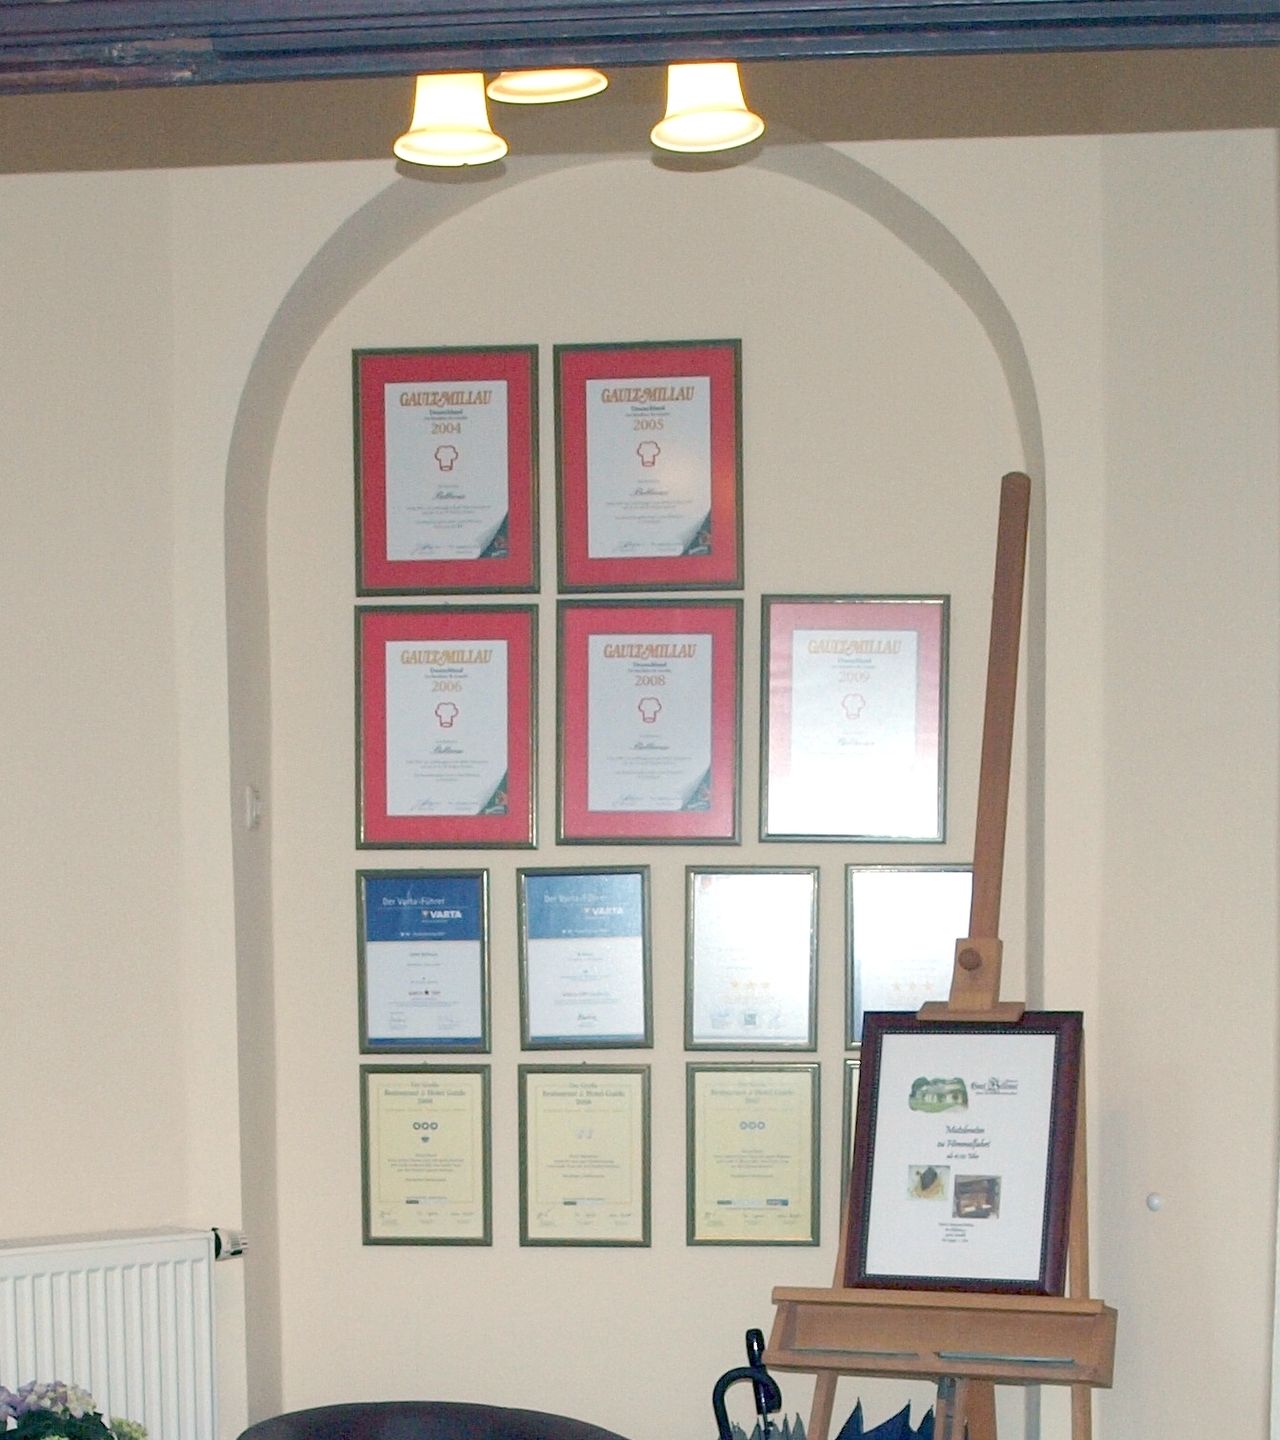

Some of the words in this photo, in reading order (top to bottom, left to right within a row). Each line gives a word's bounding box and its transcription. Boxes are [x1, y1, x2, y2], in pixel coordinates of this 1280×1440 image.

[431, 422, 461, 434] 2004
[633, 419, 664, 431] 2005
[431, 680, 463, 692] 2006
[430, 910, 462, 919] VARTA
[591, 907, 624, 916] VARTA
